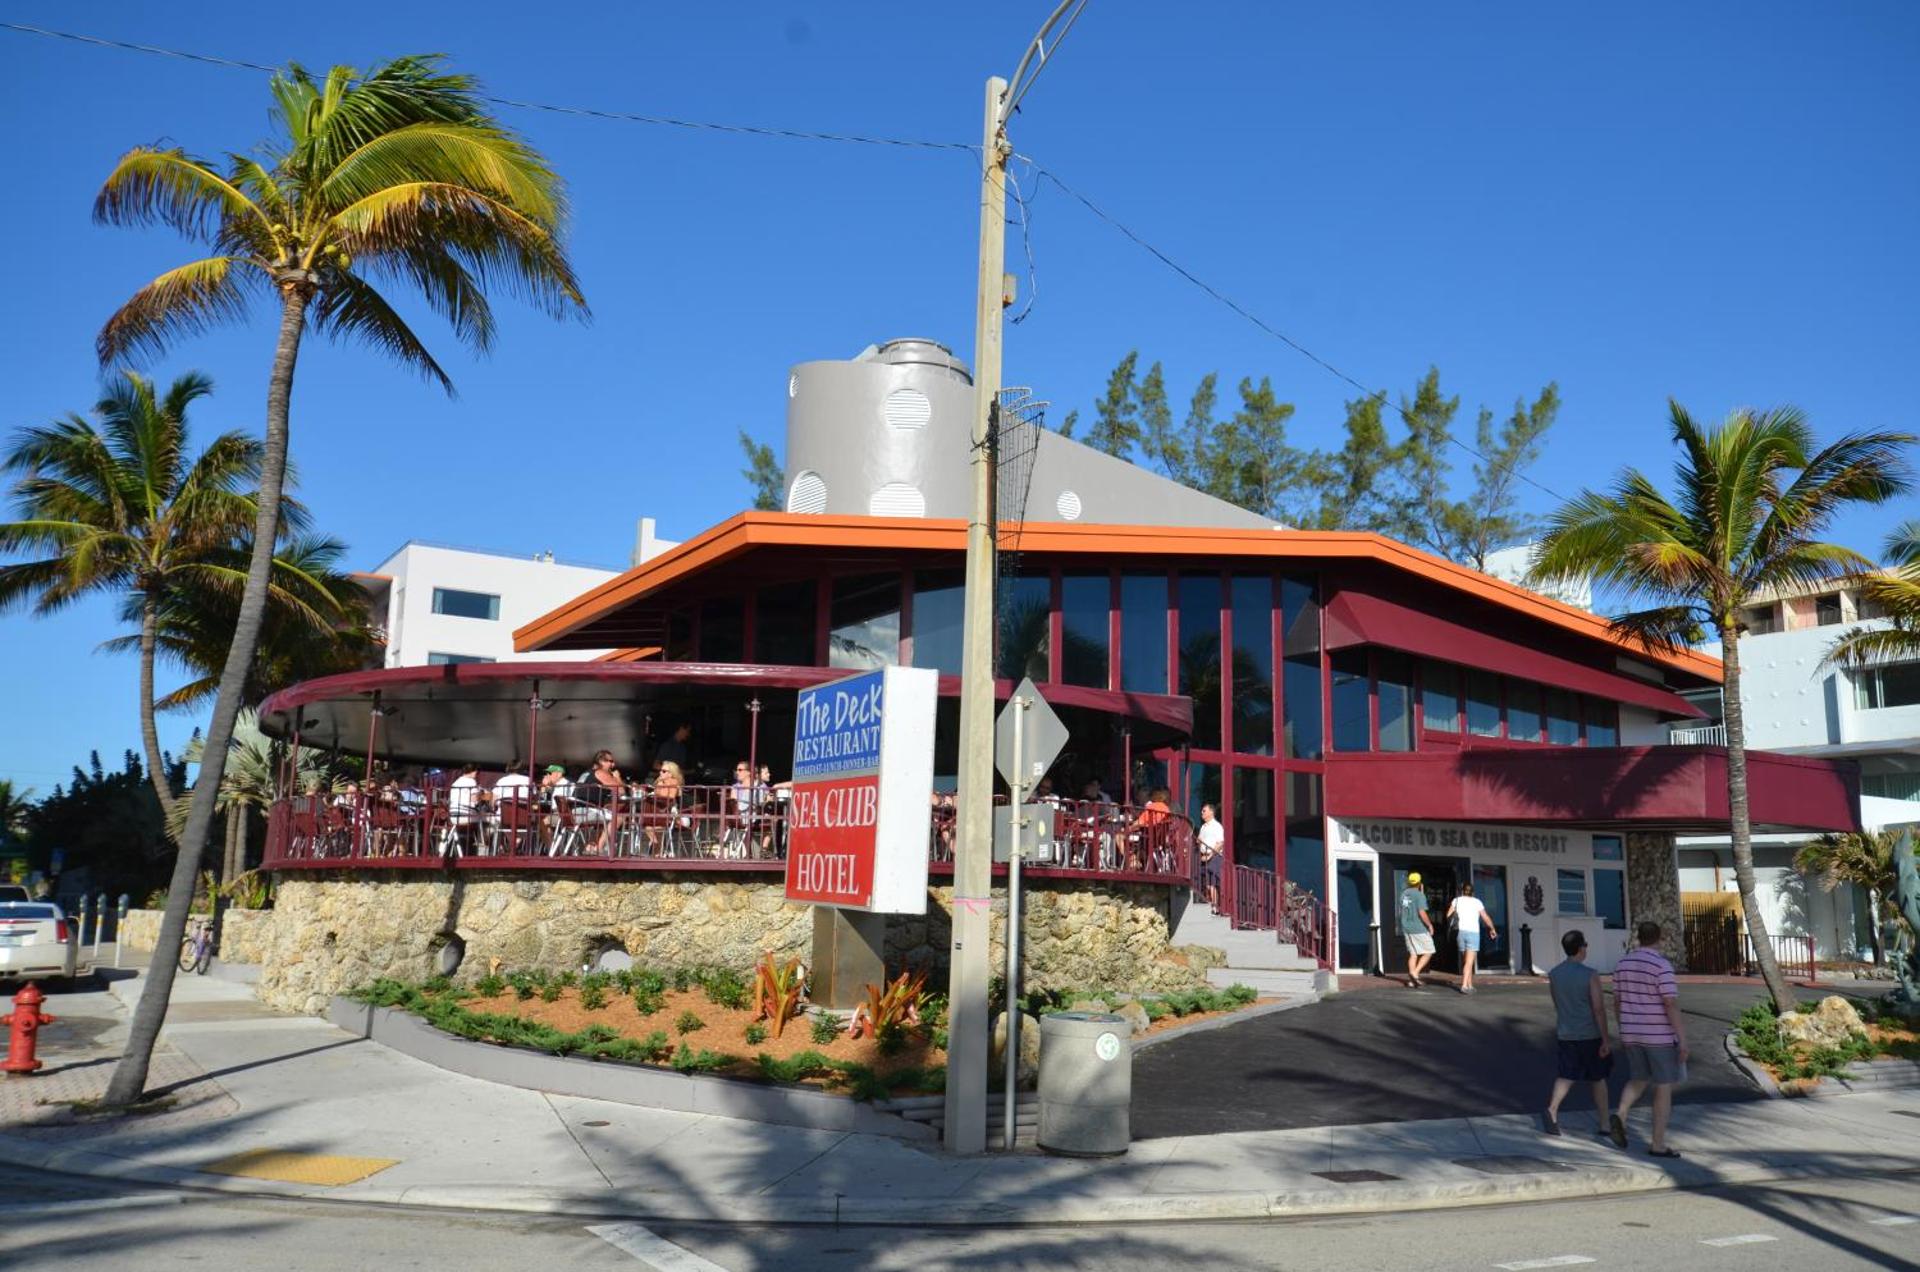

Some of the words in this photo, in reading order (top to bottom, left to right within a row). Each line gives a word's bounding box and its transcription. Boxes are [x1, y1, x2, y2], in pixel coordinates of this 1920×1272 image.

[800, 691, 831, 737] The
[796, 726, 880, 762] RESTAURANT
[789, 790, 820, 829] SEA
[824, 785, 877, 828] CLUB
[1338, 824, 1414, 845] WELCOME
[1418, 827, 1436, 846] TO
[1440, 828, 1469, 848] SEA
[1472, 831, 1510, 849] CLUB
[1513, 832, 1568, 853] RESORT
[796, 853, 859, 894] HOTEL
